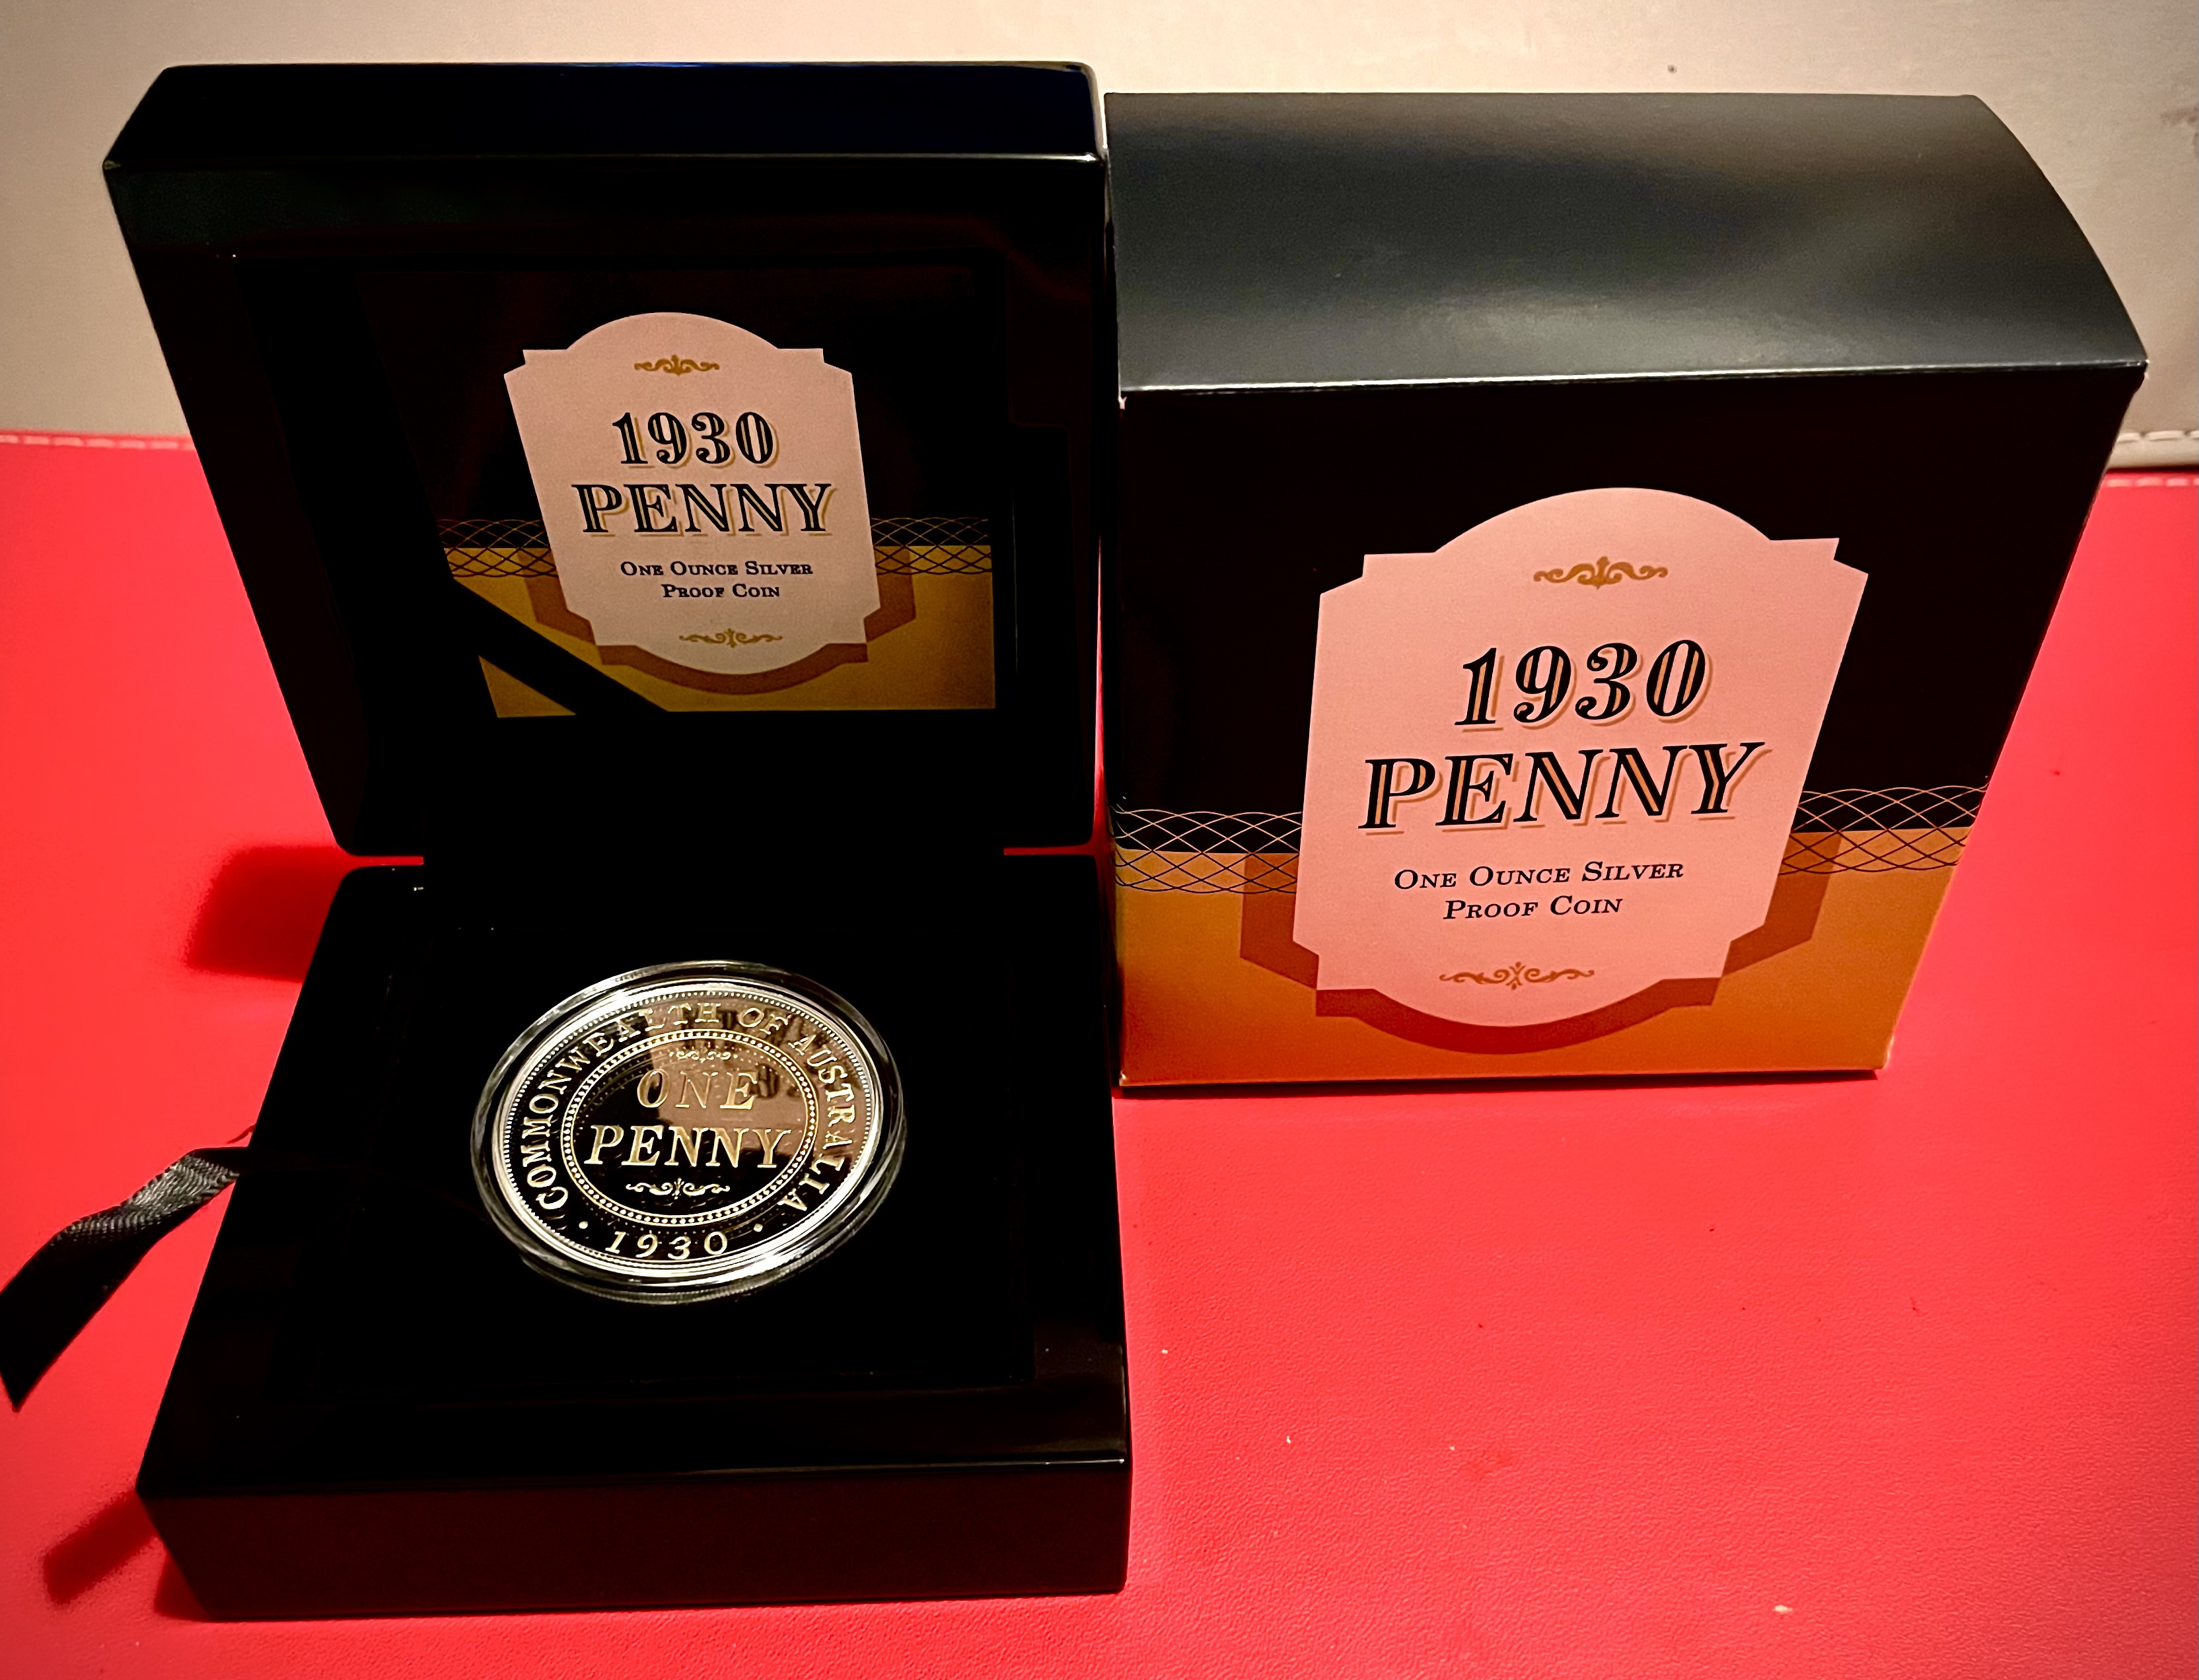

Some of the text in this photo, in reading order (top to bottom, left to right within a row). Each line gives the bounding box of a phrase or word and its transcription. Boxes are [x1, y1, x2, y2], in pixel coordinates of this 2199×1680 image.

[611, 411, 779, 466] 1930
[570, 482, 836, 534] PENNY
[620, 560, 814, 577] ONE OUNCE SILVER
[660, 582, 781, 598] PROOF COIN
[1453, 639, 1710, 728] 1930
[1357, 741, 1768, 831] PENNY
[1394, 860, 1684, 890] ONE OUNCE SILVER
[1442, 894, 1624, 921] PROOF COIN
[520, 1002, 856, 1212] COMMONWEALTH OF AUSTRALIA
[636, 1068, 758, 1109] ONE
[583, 1124, 792, 1168] PENNY
[604, 1230, 728, 1261] 1930
